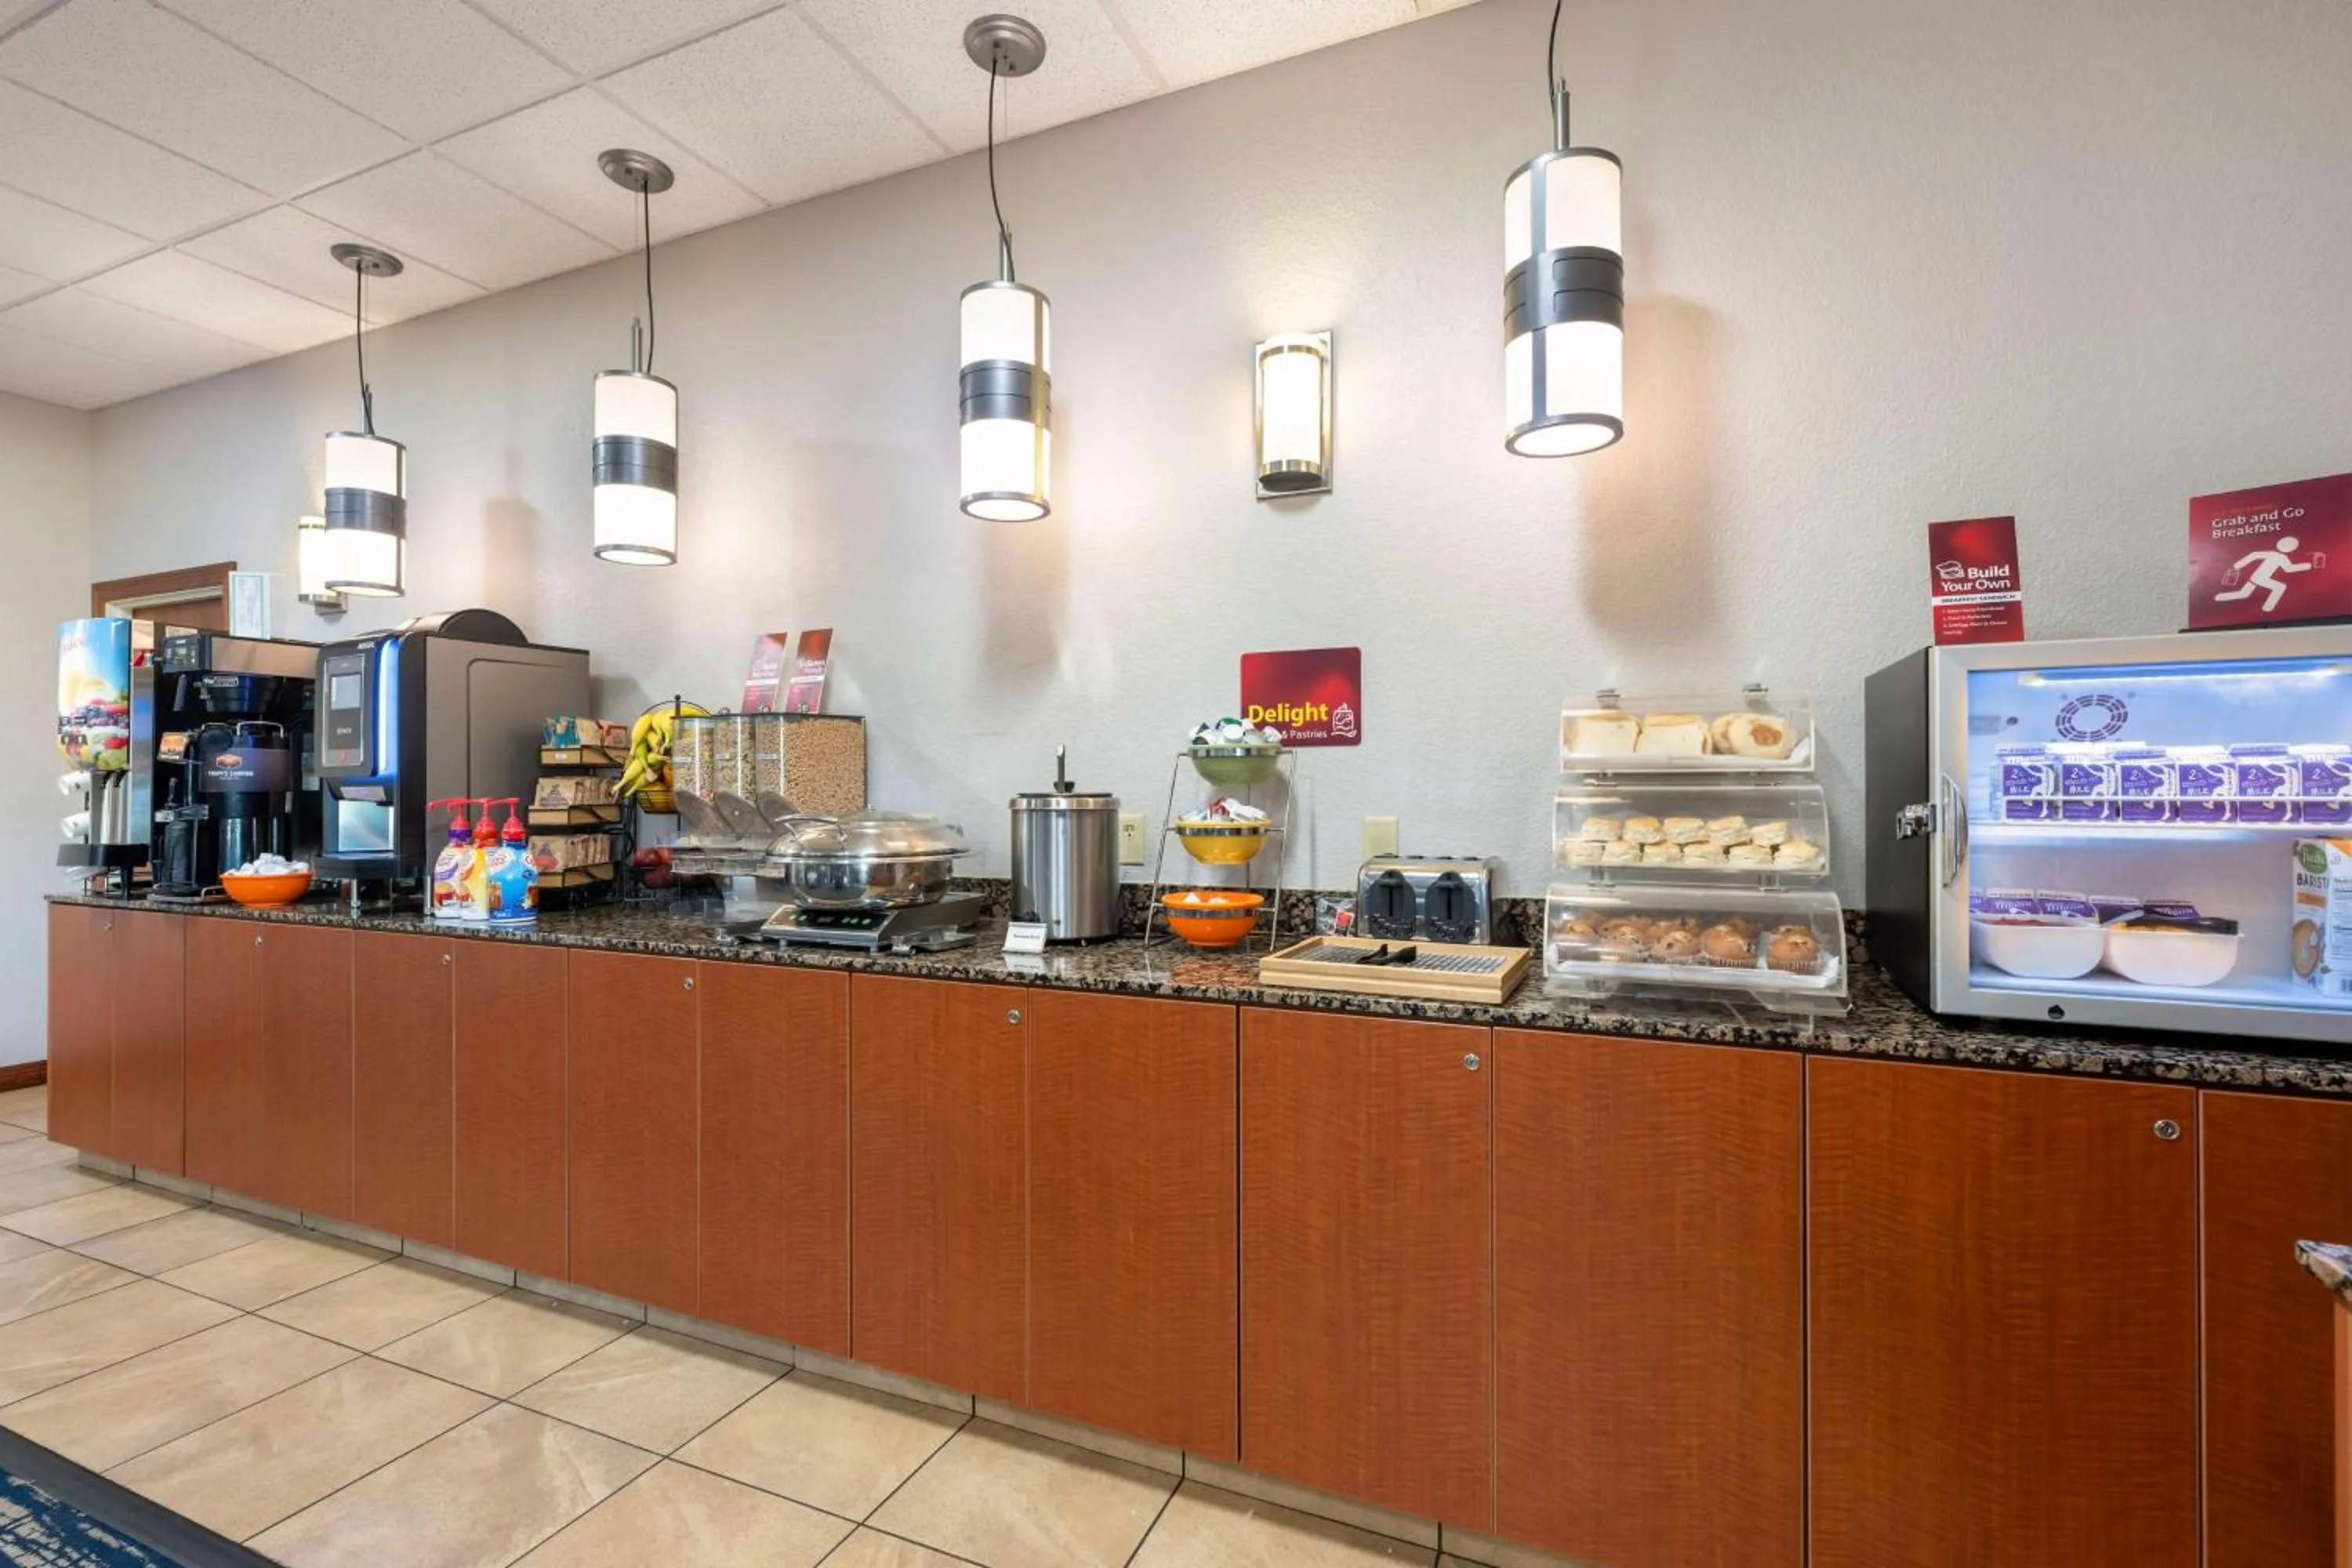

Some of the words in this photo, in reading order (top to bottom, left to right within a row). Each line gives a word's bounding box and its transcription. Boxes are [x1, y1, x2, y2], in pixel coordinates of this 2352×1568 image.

[2212, 515, 2246, 528] Grab
[2250, 510, 2278, 522] and
[2282, 507, 2305, 518] Go
[2212, 522, 2281, 539] Breakfast
[1967, 564, 2010, 579] Build
[1940, 581, 1974, 593] Your
[1975, 579, 2011, 590] Own
[1248, 702, 1329, 727] Delight
[1290, 730, 1328, 739] Pastries
